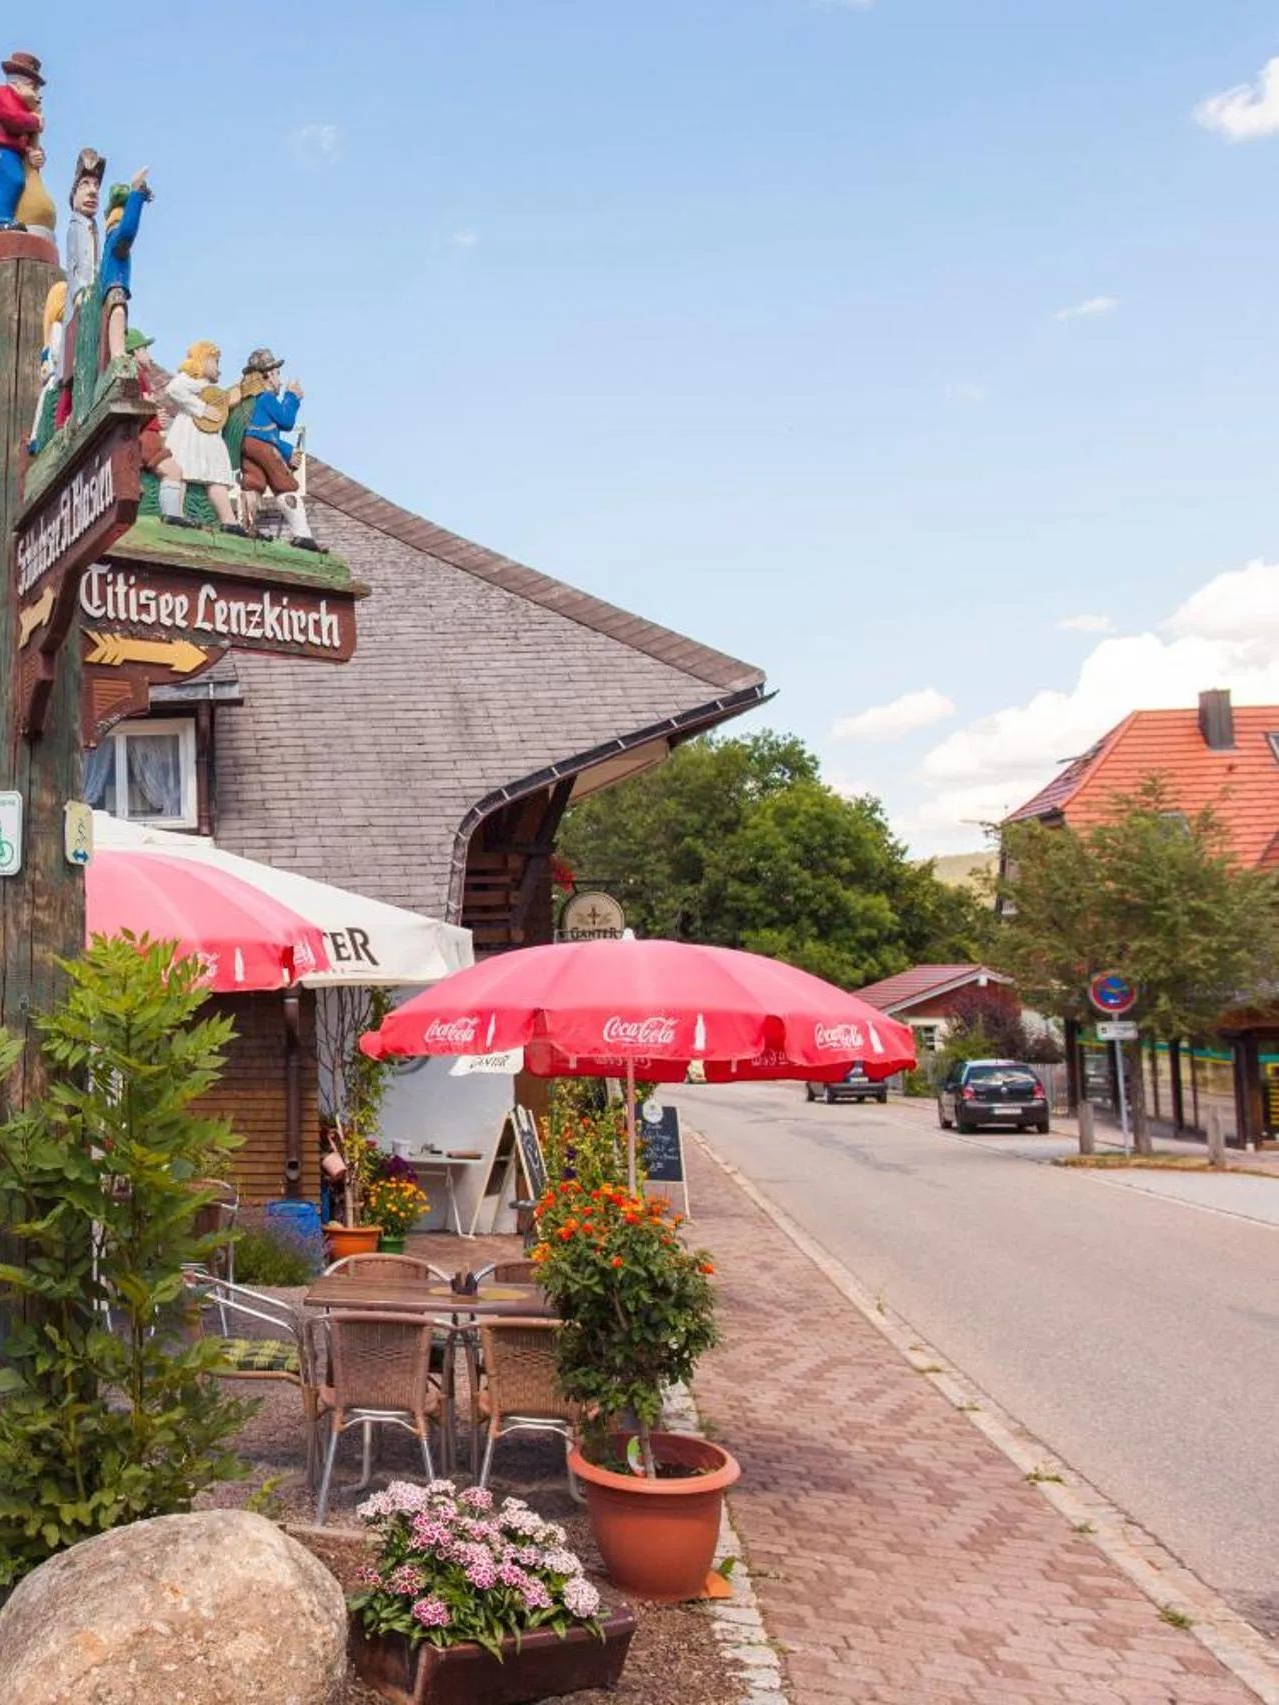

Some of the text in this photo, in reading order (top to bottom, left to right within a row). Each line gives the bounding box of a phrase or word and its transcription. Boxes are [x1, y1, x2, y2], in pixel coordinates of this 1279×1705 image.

[79, 562, 342, 648] Titisee Lenzkirch
[602, 1015, 678, 1045] Coca-Cola
